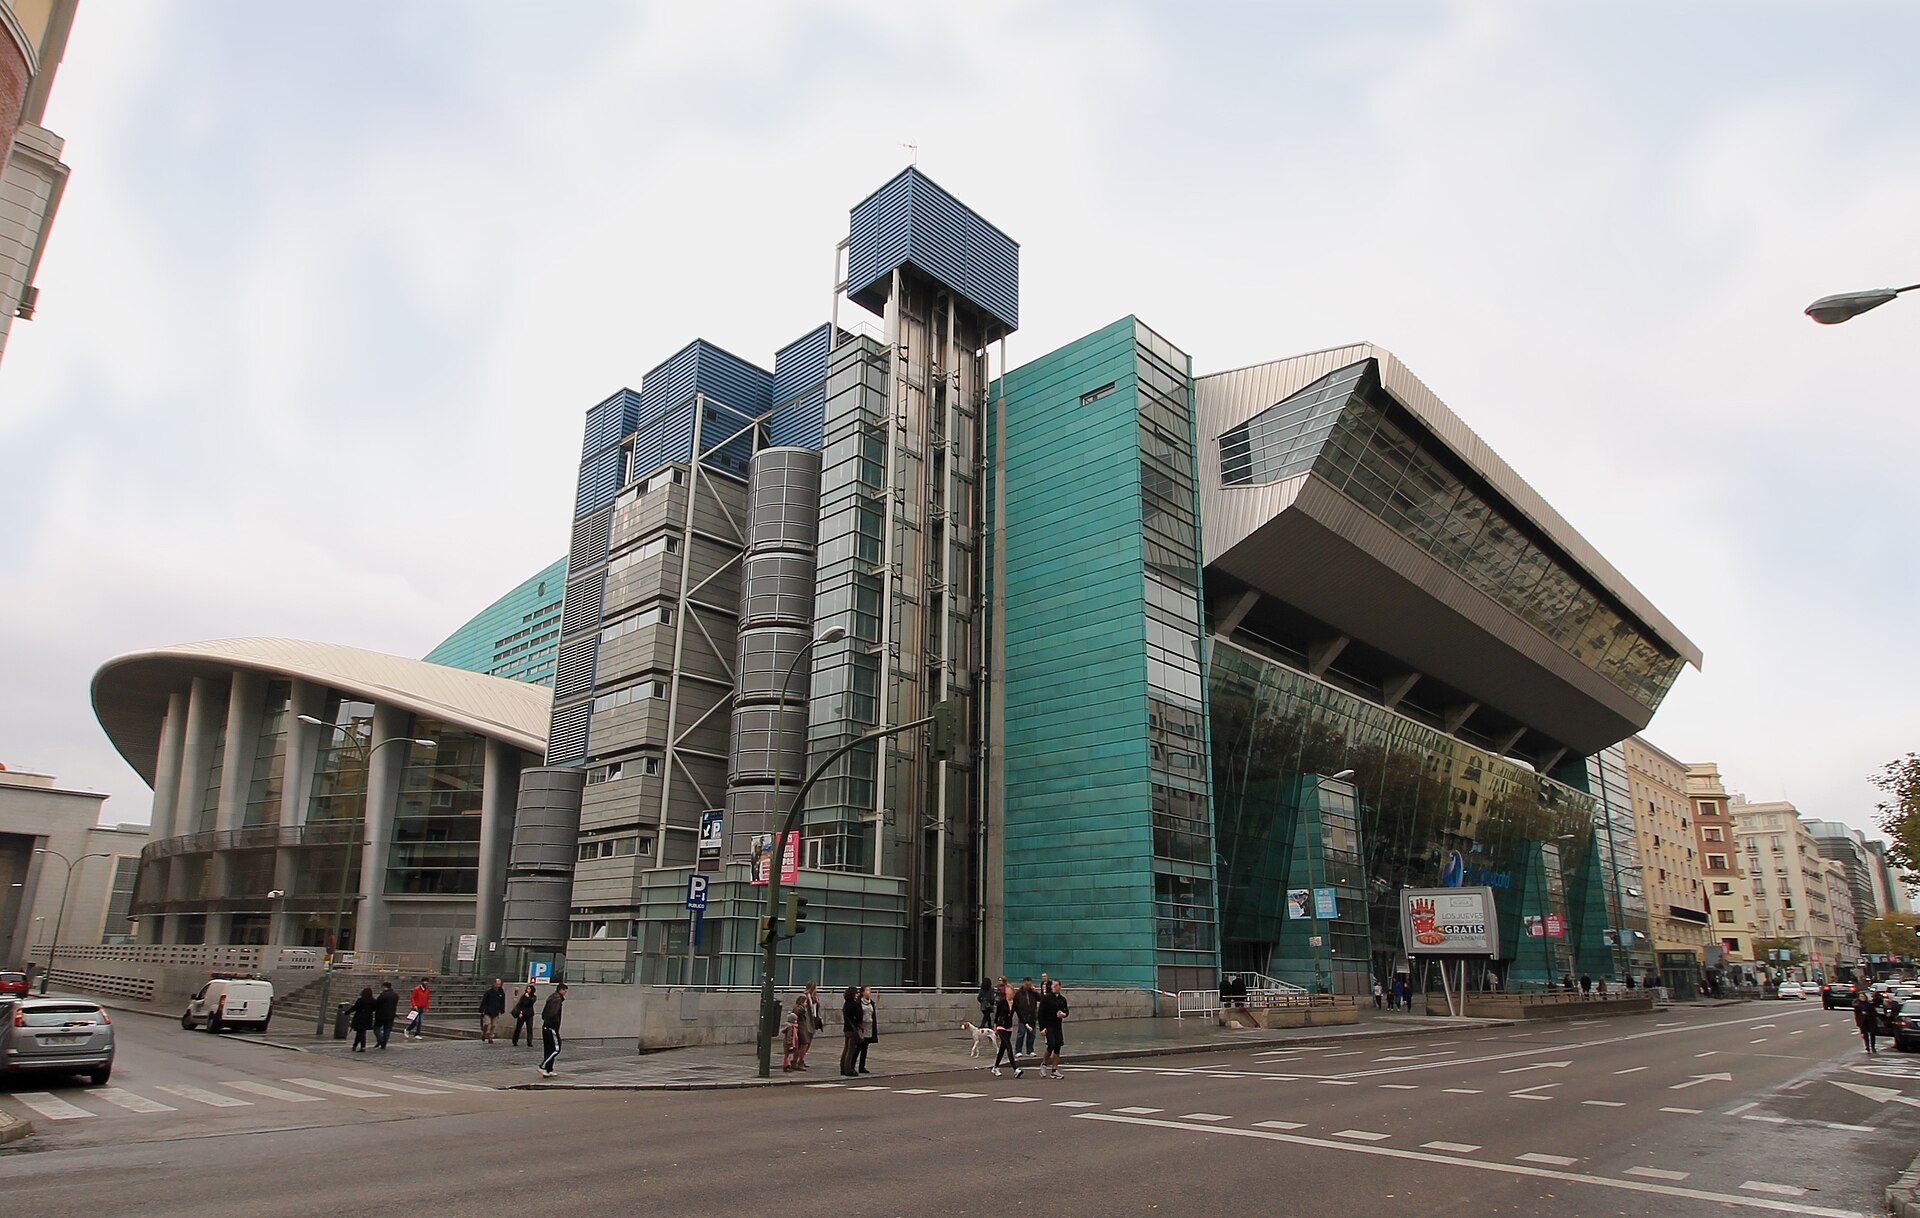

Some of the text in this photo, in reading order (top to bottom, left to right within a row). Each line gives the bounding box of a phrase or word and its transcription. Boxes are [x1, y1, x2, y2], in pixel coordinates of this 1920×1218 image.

[690, 877, 706, 900] P
[1442, 912, 1483, 920] LOS JUEVES
[1444, 925, 1484, 934] GRATIS
[536, 963, 547, 977] P
